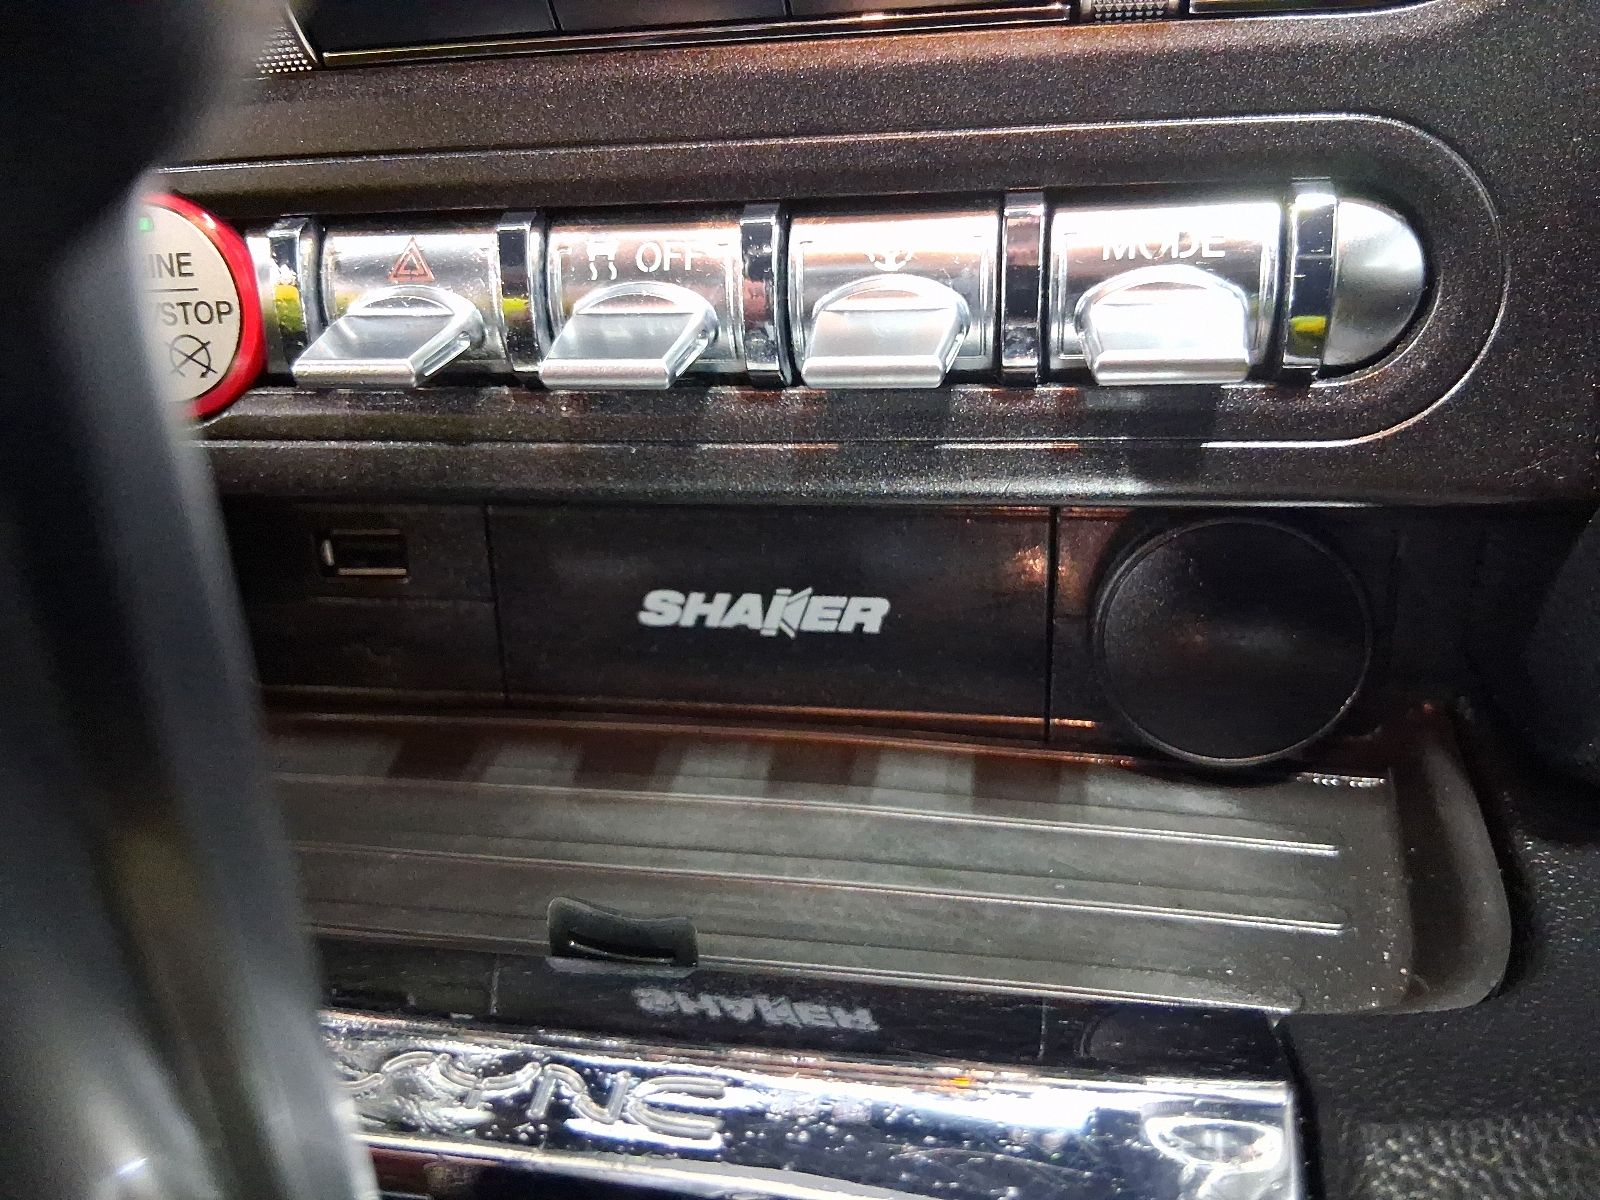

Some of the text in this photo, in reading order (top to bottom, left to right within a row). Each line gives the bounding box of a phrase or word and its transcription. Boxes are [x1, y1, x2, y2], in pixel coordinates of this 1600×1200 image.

[635, 240, 705, 272] OFF
[1101, 229, 1226, 260] MODE
[637, 587, 891, 639] SHAKER
